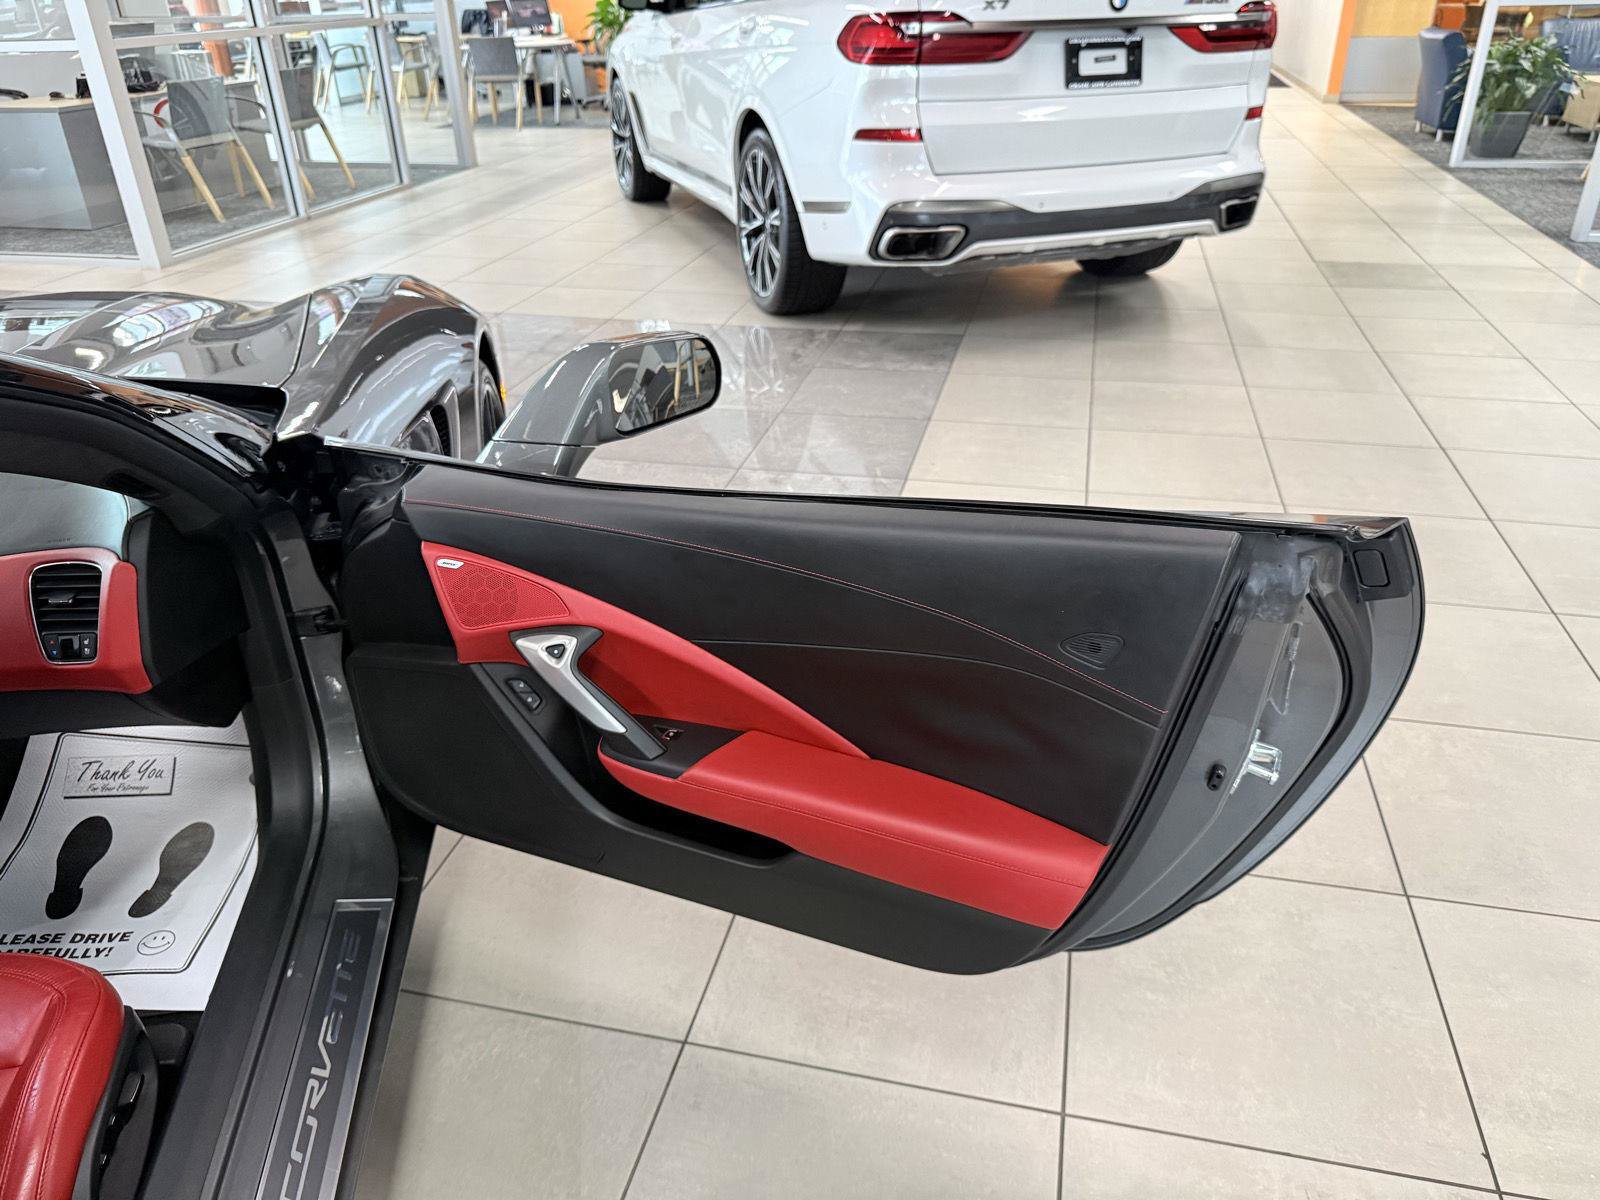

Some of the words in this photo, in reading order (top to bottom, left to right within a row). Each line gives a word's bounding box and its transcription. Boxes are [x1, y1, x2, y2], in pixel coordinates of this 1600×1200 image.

[77, 760, 135, 782] Thank
[138, 759, 164, 781] You
[69, 931, 134, 944] DRIVE
